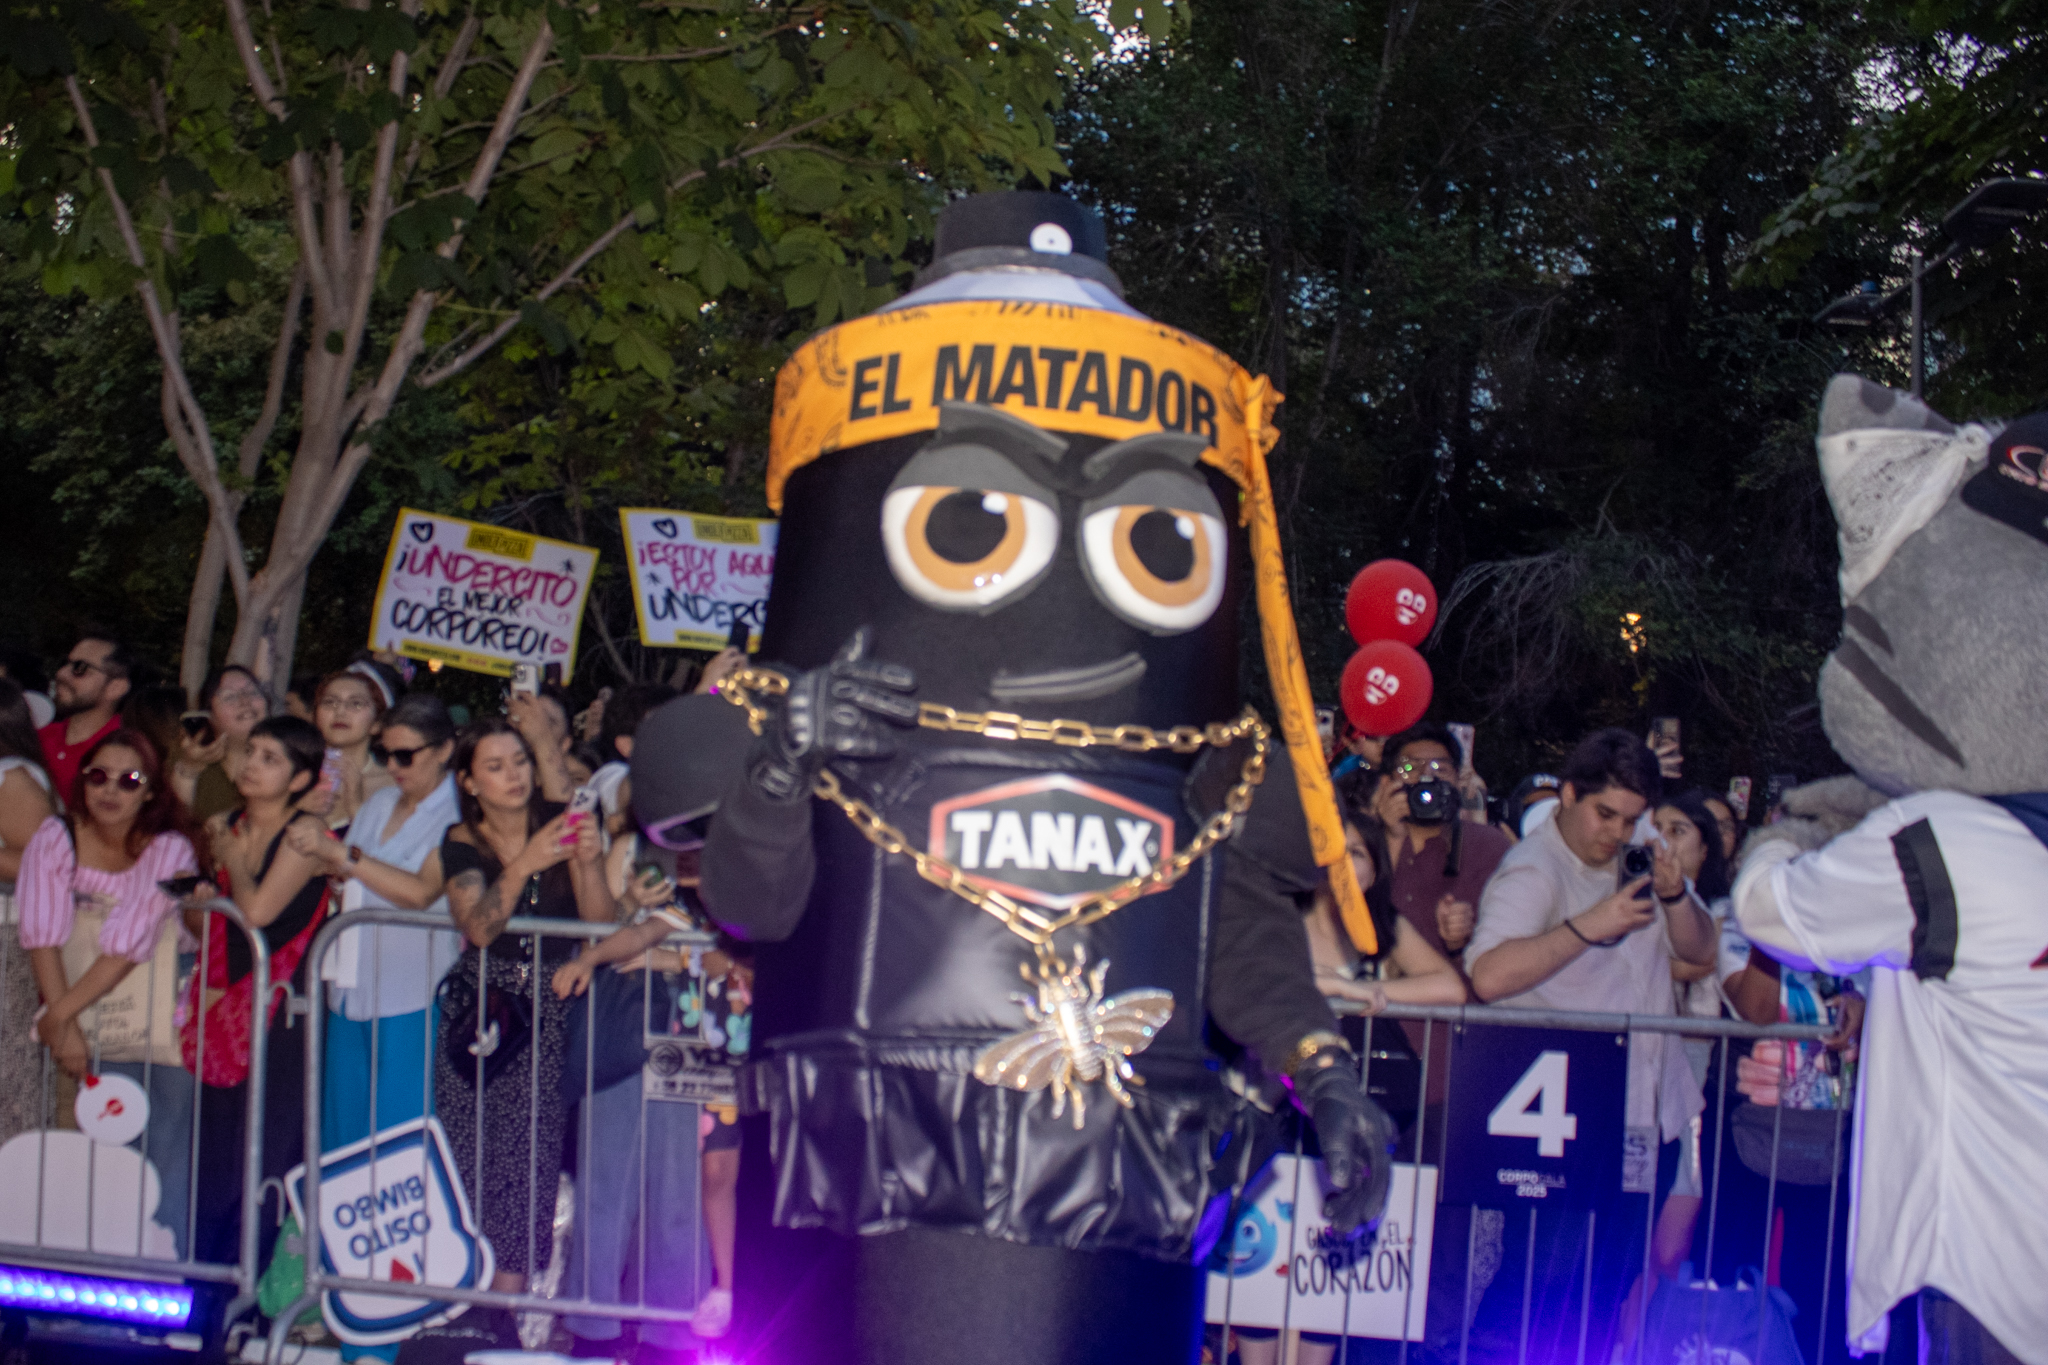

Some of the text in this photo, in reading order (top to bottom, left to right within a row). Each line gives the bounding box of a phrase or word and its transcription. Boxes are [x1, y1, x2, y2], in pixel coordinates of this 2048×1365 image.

[848, 343, 1219, 450] EL MATADOR
[437, 586, 525, 616] EL MEJOR
[671, 565, 718, 597] POR
[390, 597, 550, 661] CORPOREO!
[951, 809, 1153, 878] TANAX
[1487, 1050, 1578, 1158] 4
[333, 1174, 425, 1230] BIMBO
[1515, 1182, 1548, 1198] 2025
[348, 1209, 431, 1260] OSITO
